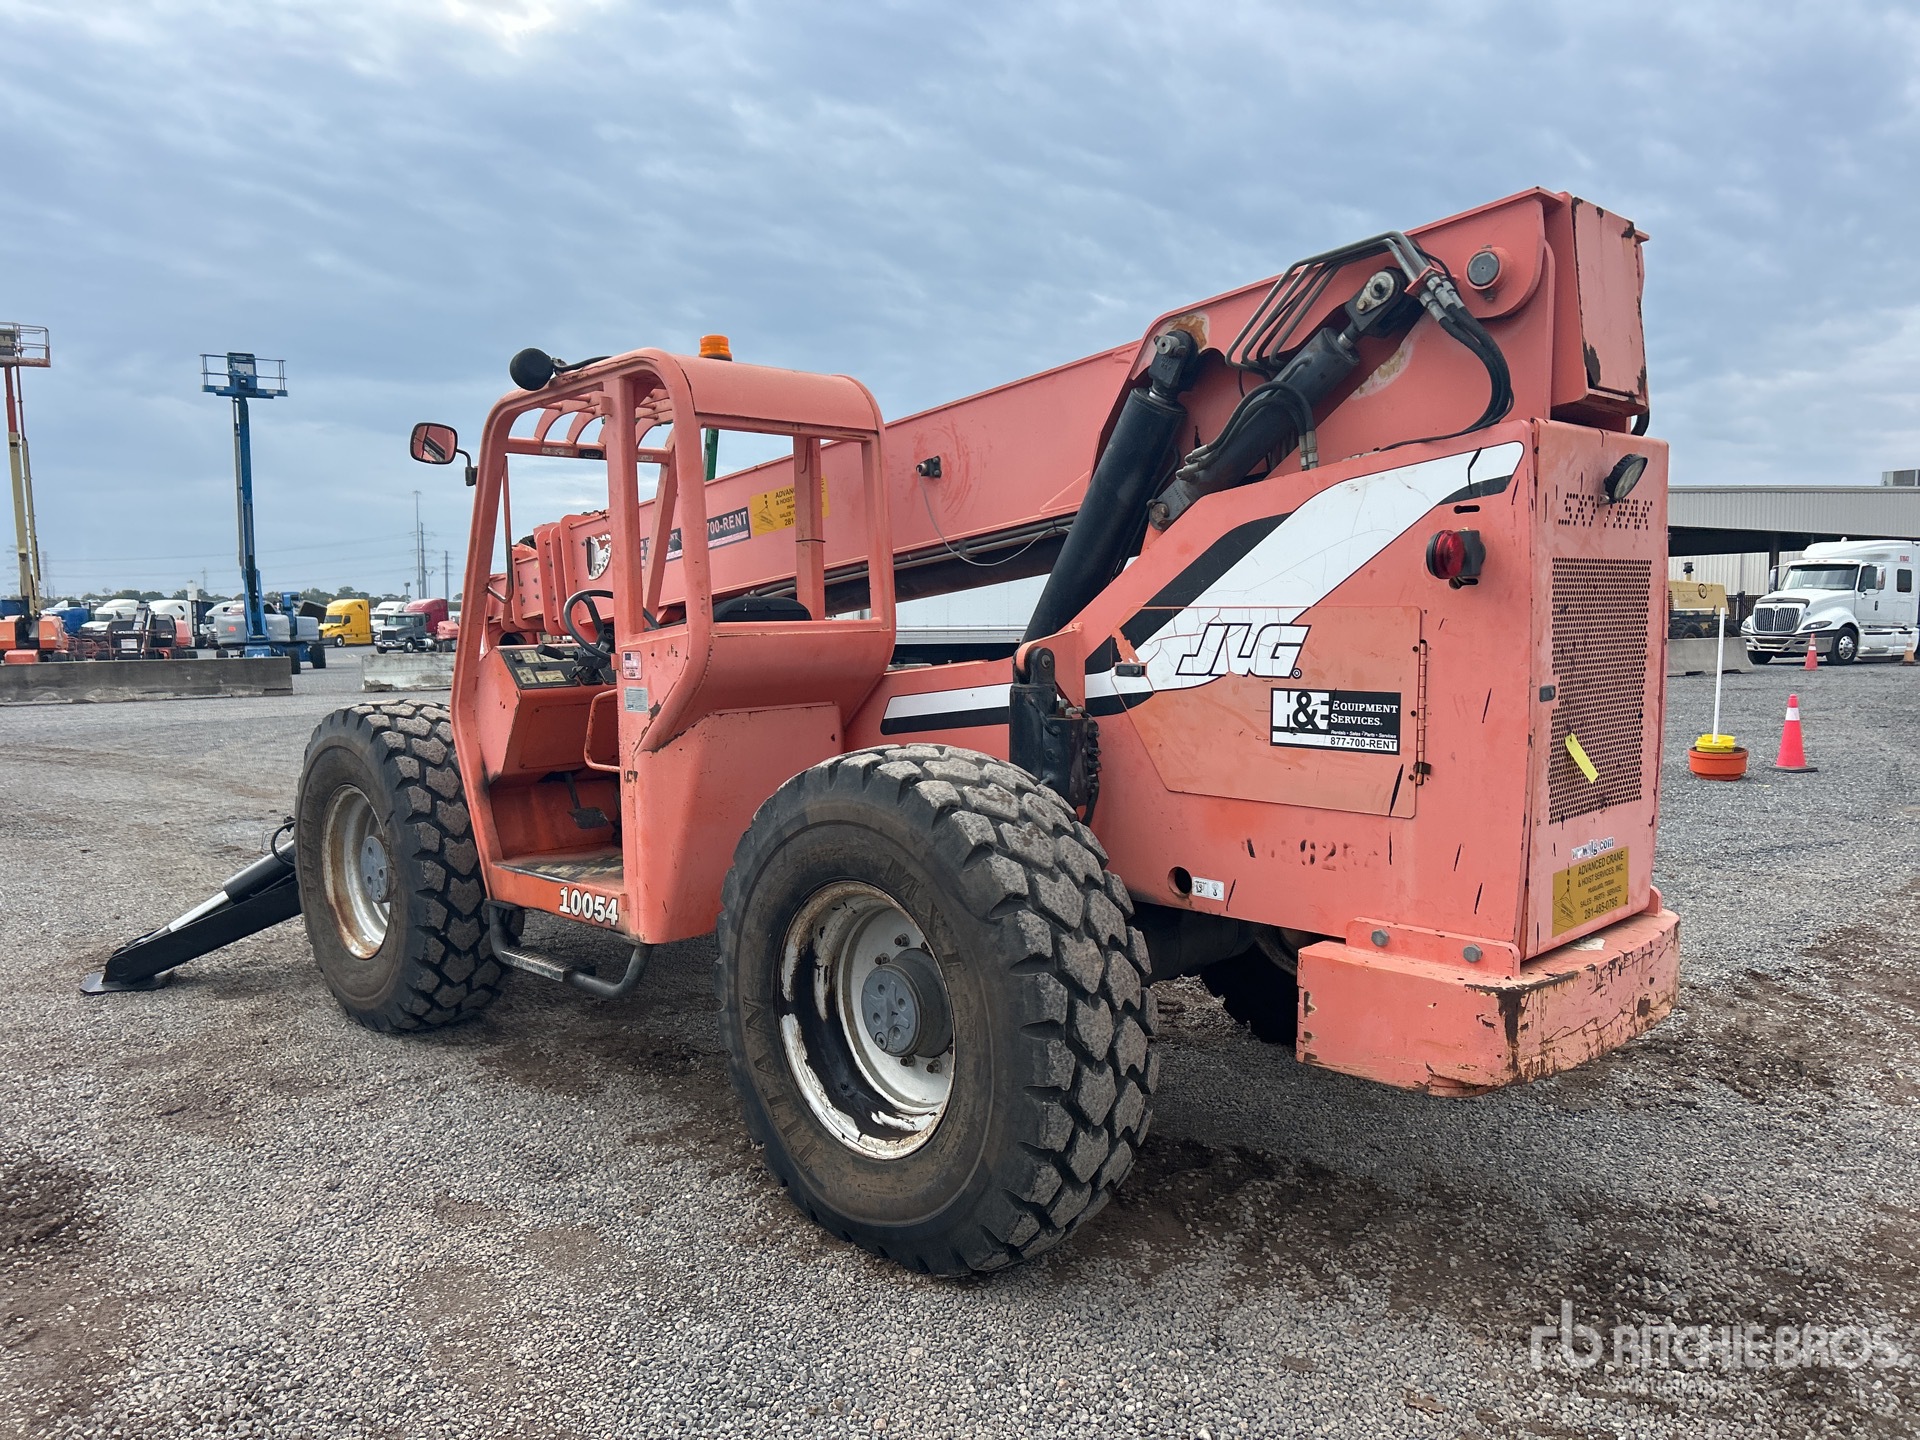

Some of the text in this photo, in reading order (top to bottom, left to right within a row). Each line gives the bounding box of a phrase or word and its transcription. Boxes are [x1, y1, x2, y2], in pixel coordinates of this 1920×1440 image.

[1175, 623, 1312, 679] JLG
[1272, 690, 1330, 730] H&E
[1330, 736, 1397, 750] 877-700-RENT
[1578, 851, 1624, 876] ADVANCED CRANE
[1581, 874, 1594, 887] HOIST
[559, 886, 619, 926] 10054
[1580, 898, 1592, 908] SALES
[743, 994, 822, 1173] TITAN
